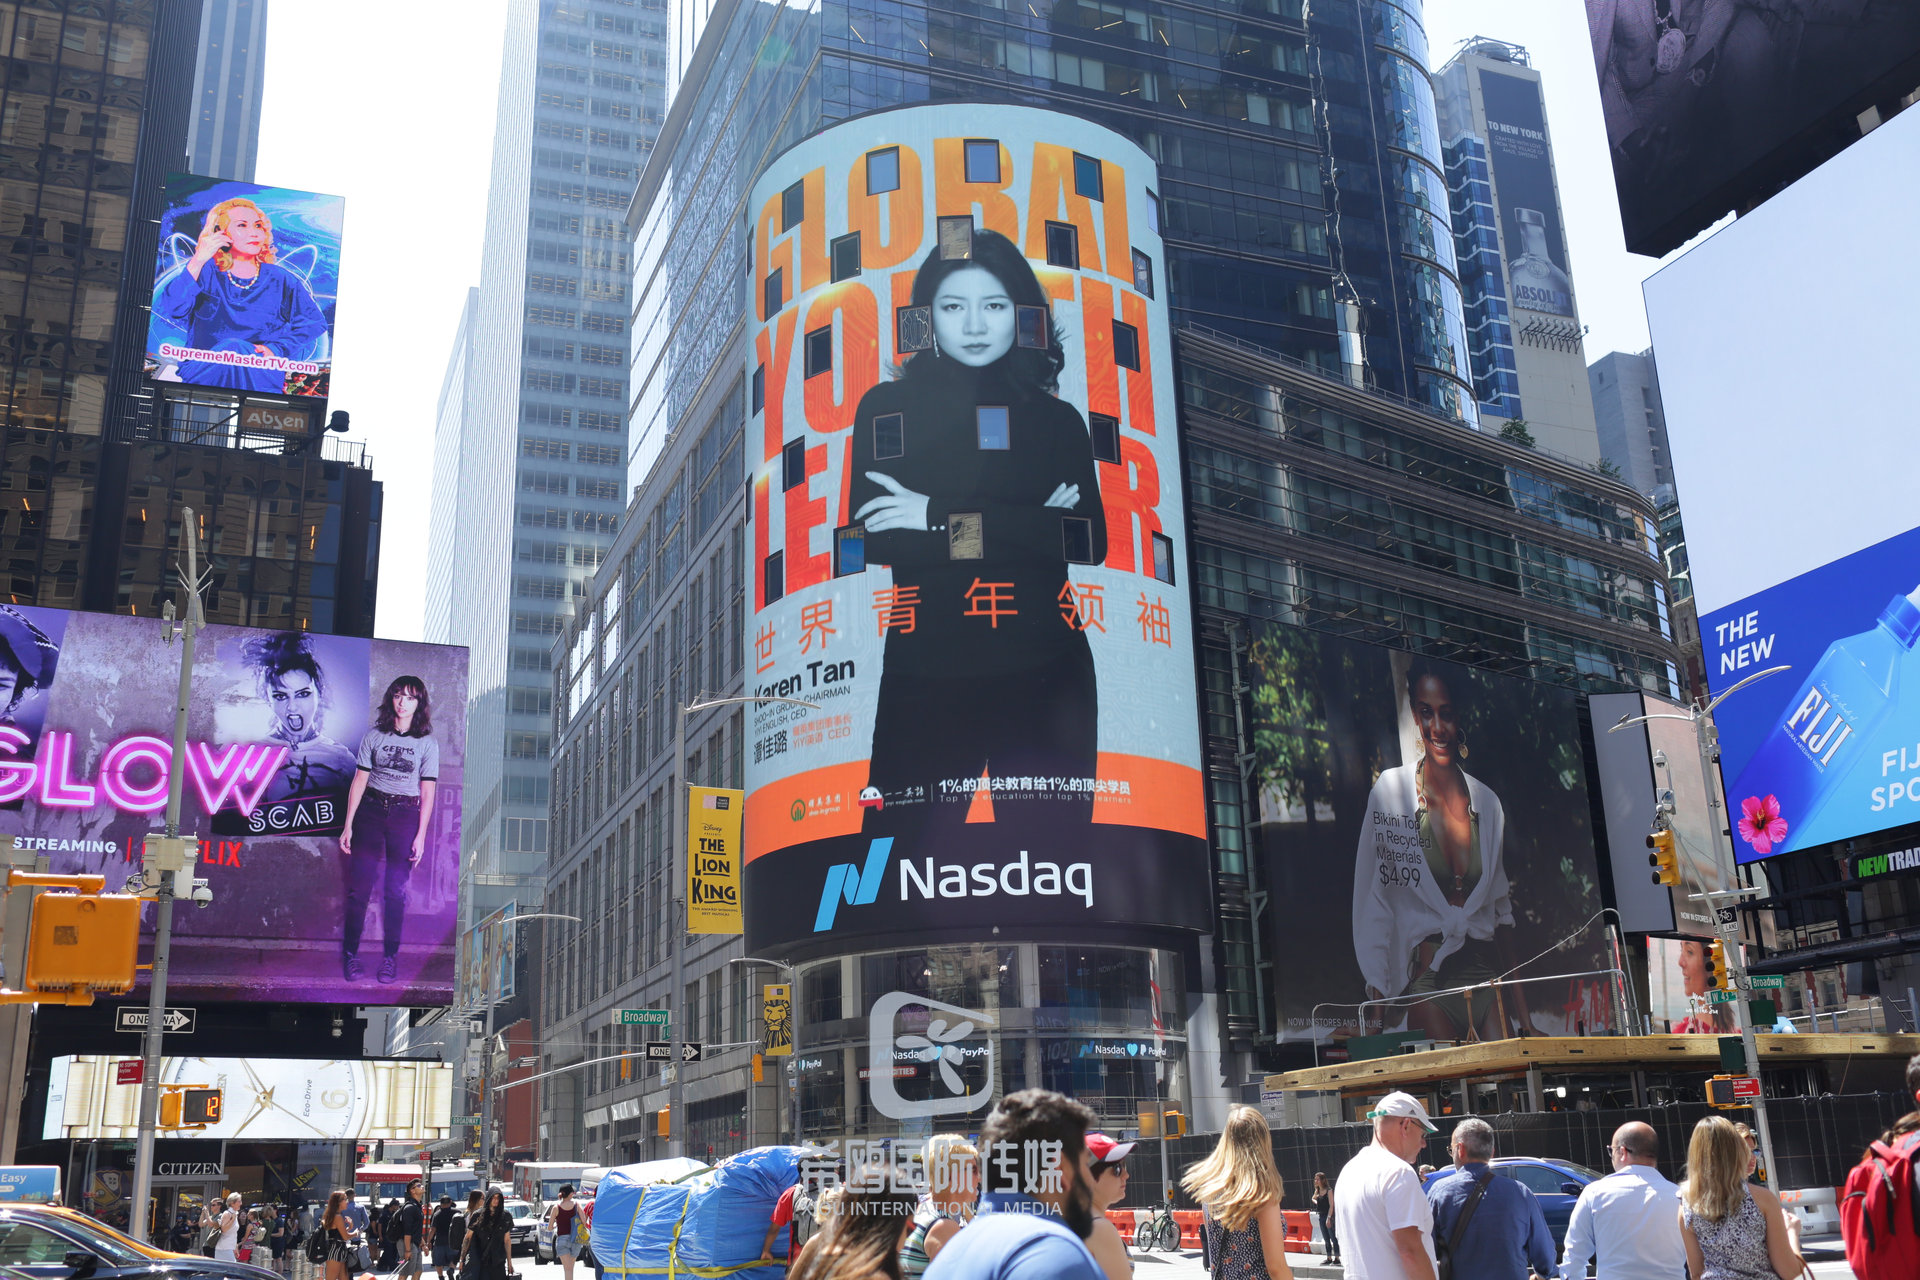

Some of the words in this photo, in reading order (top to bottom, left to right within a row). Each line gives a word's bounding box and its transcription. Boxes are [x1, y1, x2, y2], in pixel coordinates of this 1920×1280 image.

[1488, 121, 1499, 131] TO
[1500, 123, 1519, 135] NEW
[755, 137, 1134, 322] GLOBAL
[161, 344, 317, 374] SupremeMasterTV.com
[246, 411, 304, 430] Absen
[755, 577, 1172, 675] 世界青年领袖
[1715, 610, 1759, 647] THE
[1720, 633, 1776, 675] NEW
[755, 673, 802, 712] Karen
[807, 660, 855, 688] Tan
[803, 685, 851, 703] CHAIRMAN
[790, 707, 807, 721] CEO
[827, 726, 851, 740] CEO
[1782, 724, 1798, 743] NATURAL
[1786, 685, 1854, 767] FIJI
[939, 776, 1131, 796] 1%的顶尖教育给1%的顶尖学员
[940, 795, 958, 803] Top
[964, 793, 977, 801] 1%
[983, 792, 1035, 801] education
[1039, 792, 1053, 800] for
[1057, 793, 1073, 801] top
[1078, 793, 1091, 801] 1%
[1095, 794, 1131, 805] learners
[249, 800, 334, 832] SCAB
[1373, 811, 1399, 828] Bikini
[1402, 815, 1421, 832] Top
[12, 836, 117, 854] STREAMING
[699, 837, 725, 852] THE
[1375, 828, 1384, 843] in
[1386, 830, 1432, 849] Recycled
[695, 853, 730, 876] LION
[1376, 846, 1422, 864] Materials
[900, 850, 1094, 908] Nasdaq
[1379, 863, 1421, 887] $4.99
[692, 877, 736, 904] KING
[1752, 976, 1783, 987] Broadway
[624, 1012, 667, 1025] Broadway
[1287, 1017, 1305, 1027] NOW
[1315, 1018, 1341, 1027] STORES
[1342, 1019, 1357, 1027] AND
[653, 1048, 670, 1056] ONE
[959, 1047, 990, 1057] PayPa
[1095, 1045, 1126, 1056] Nasdaq
[1148, 1046, 1167, 1056] PayPal
[806, 1058, 823, 1069] PayPal
[206, 1096, 219, 1117] 12
[303, 1079, 313, 1118] Eco-Drive
[453, 1117, 479, 1125] BROADWAY
[158, 1162, 223, 1176] CITIZEN
[1, 1174, 27, 1184] Easy
